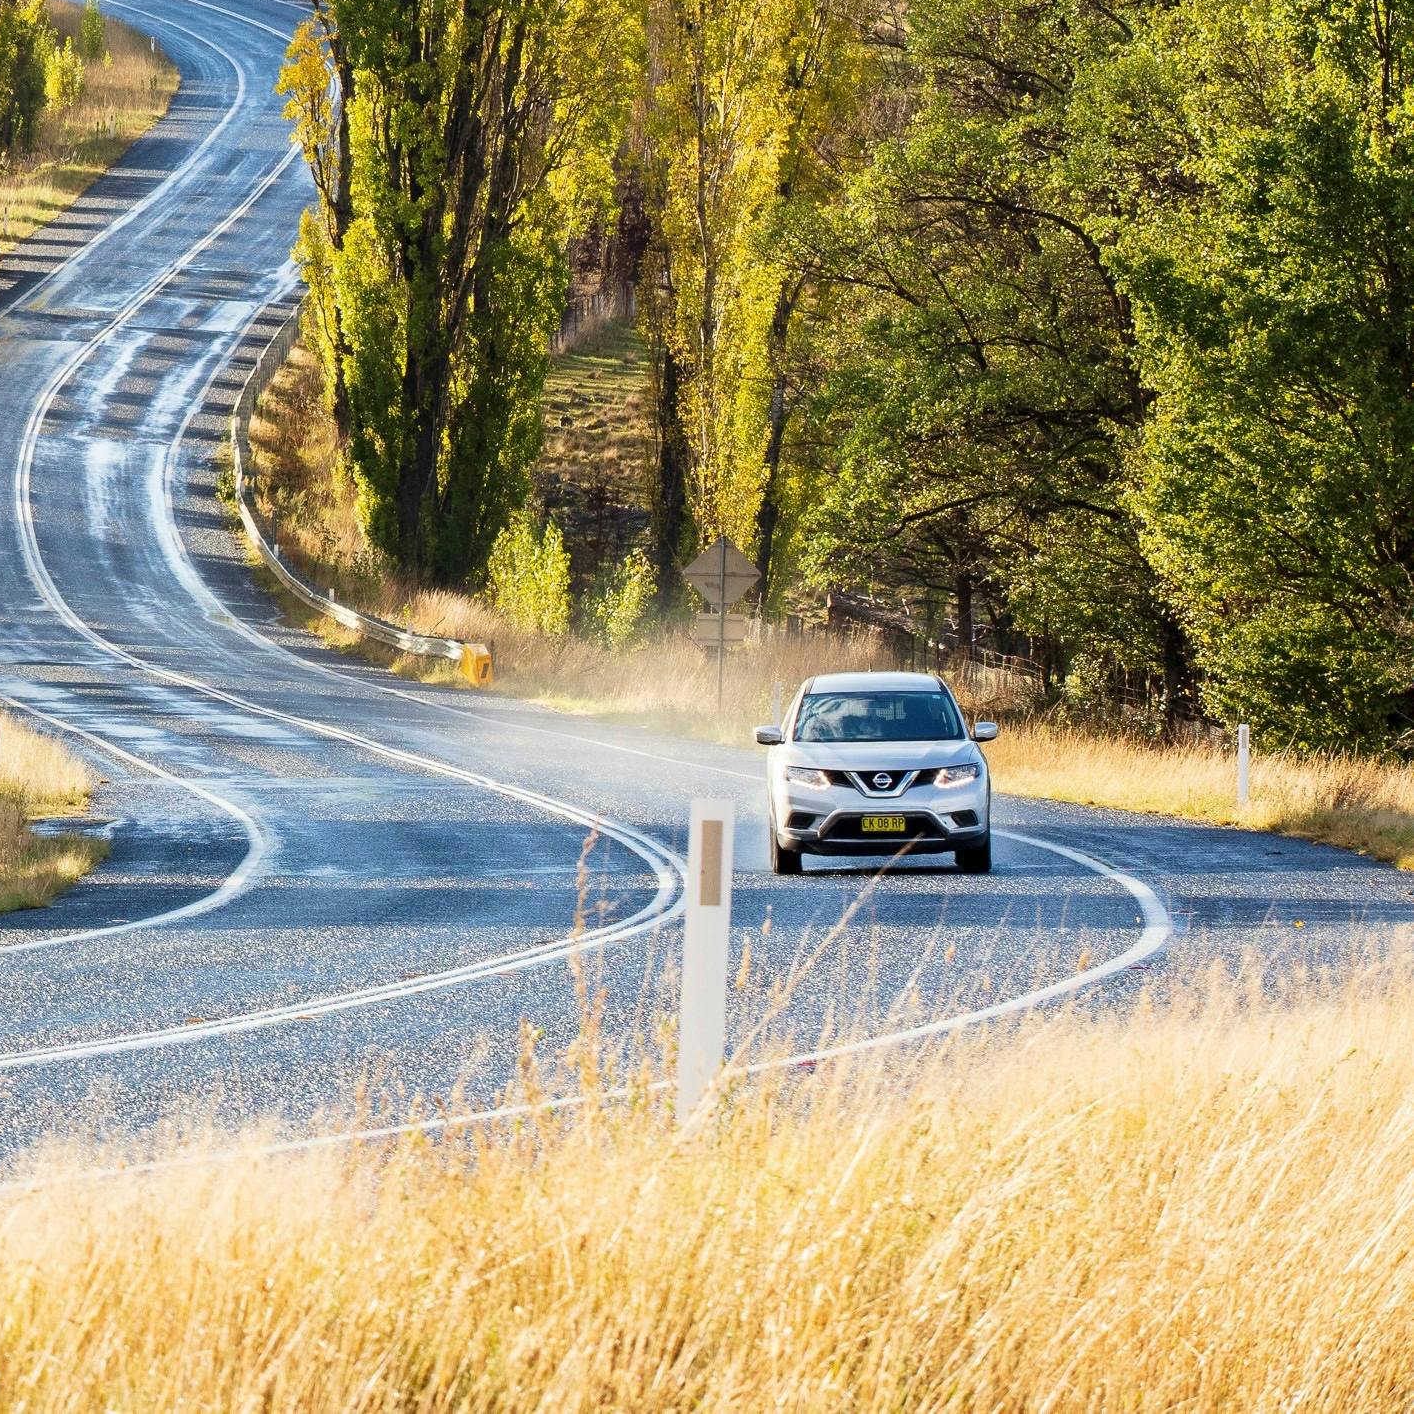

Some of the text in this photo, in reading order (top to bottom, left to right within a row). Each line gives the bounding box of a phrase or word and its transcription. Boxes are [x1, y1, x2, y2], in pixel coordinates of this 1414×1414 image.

[863, 818, 904, 828] CK 08 RP
